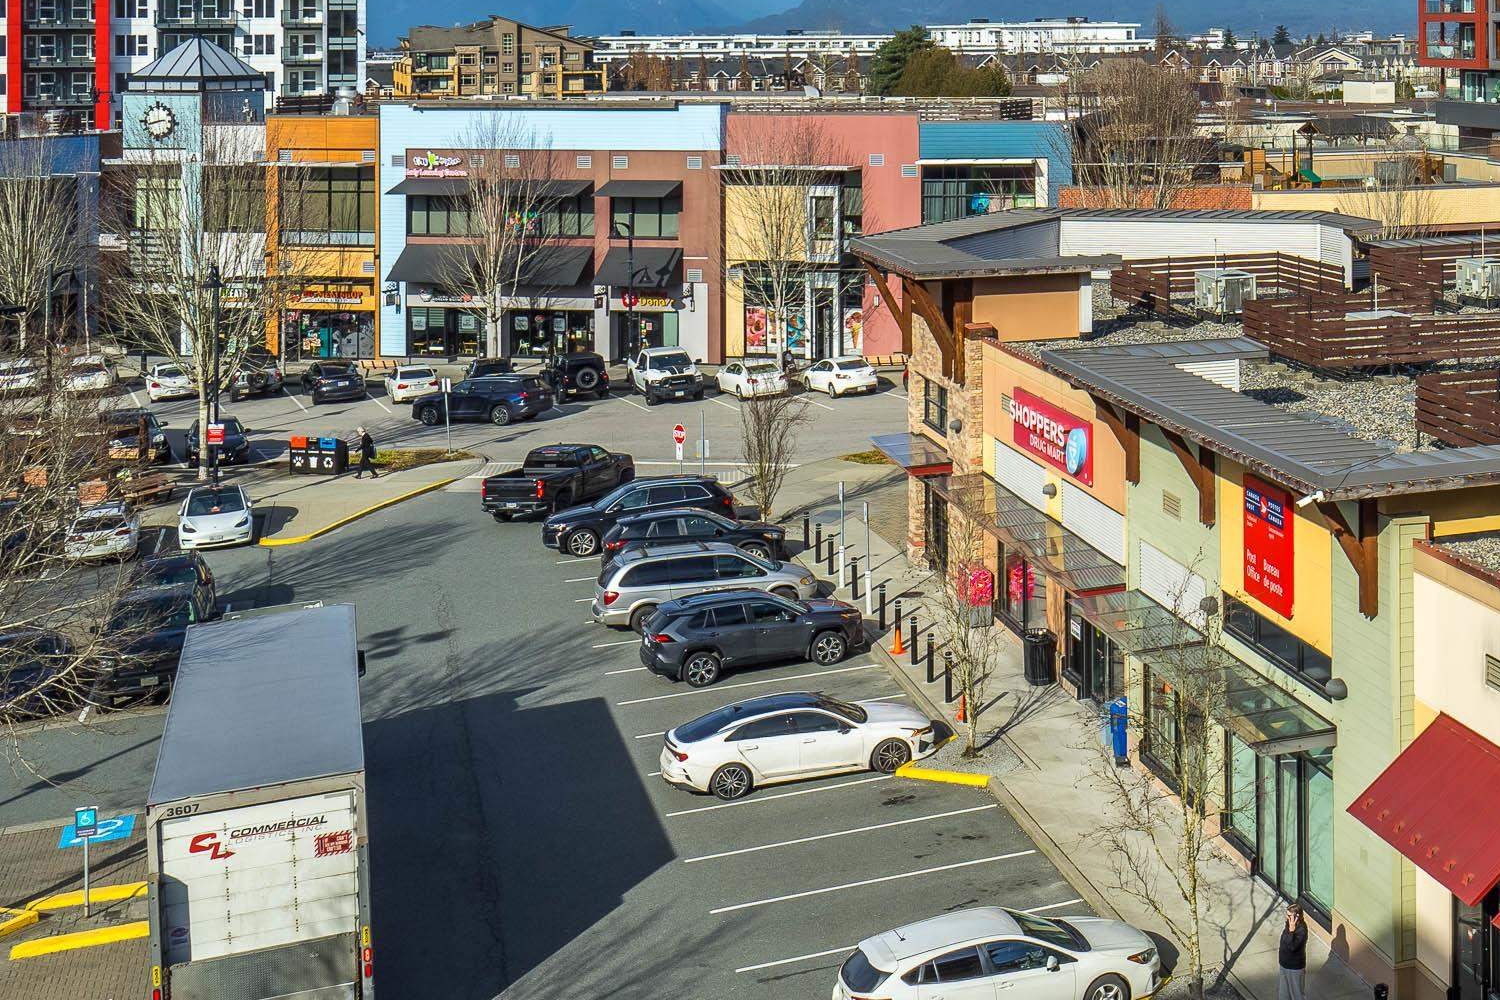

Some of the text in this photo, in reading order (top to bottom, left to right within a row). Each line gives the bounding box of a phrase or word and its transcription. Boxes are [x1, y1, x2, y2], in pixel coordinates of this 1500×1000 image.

[1009, 399, 1065, 448] SHOPPERS
[1029, 433, 1065, 464] DRUG MART
[1246, 490, 1260, 502] CANADA
[1246, 502, 1256, 512] POST
[1268, 501, 1281, 513] POSTES
[1268, 513, 1282, 526] CANADA
[1246, 548, 1257, 565] Post
[1247, 564, 1260, 583] Office
[1263, 558, 1280, 579] Bureau
[1263, 574, 1284, 597] de poste
[166, 803, 200, 817] 3607
[230, 815, 328, 838] COMMERCIAL
[228, 829, 294, 846] LOGISTICS
